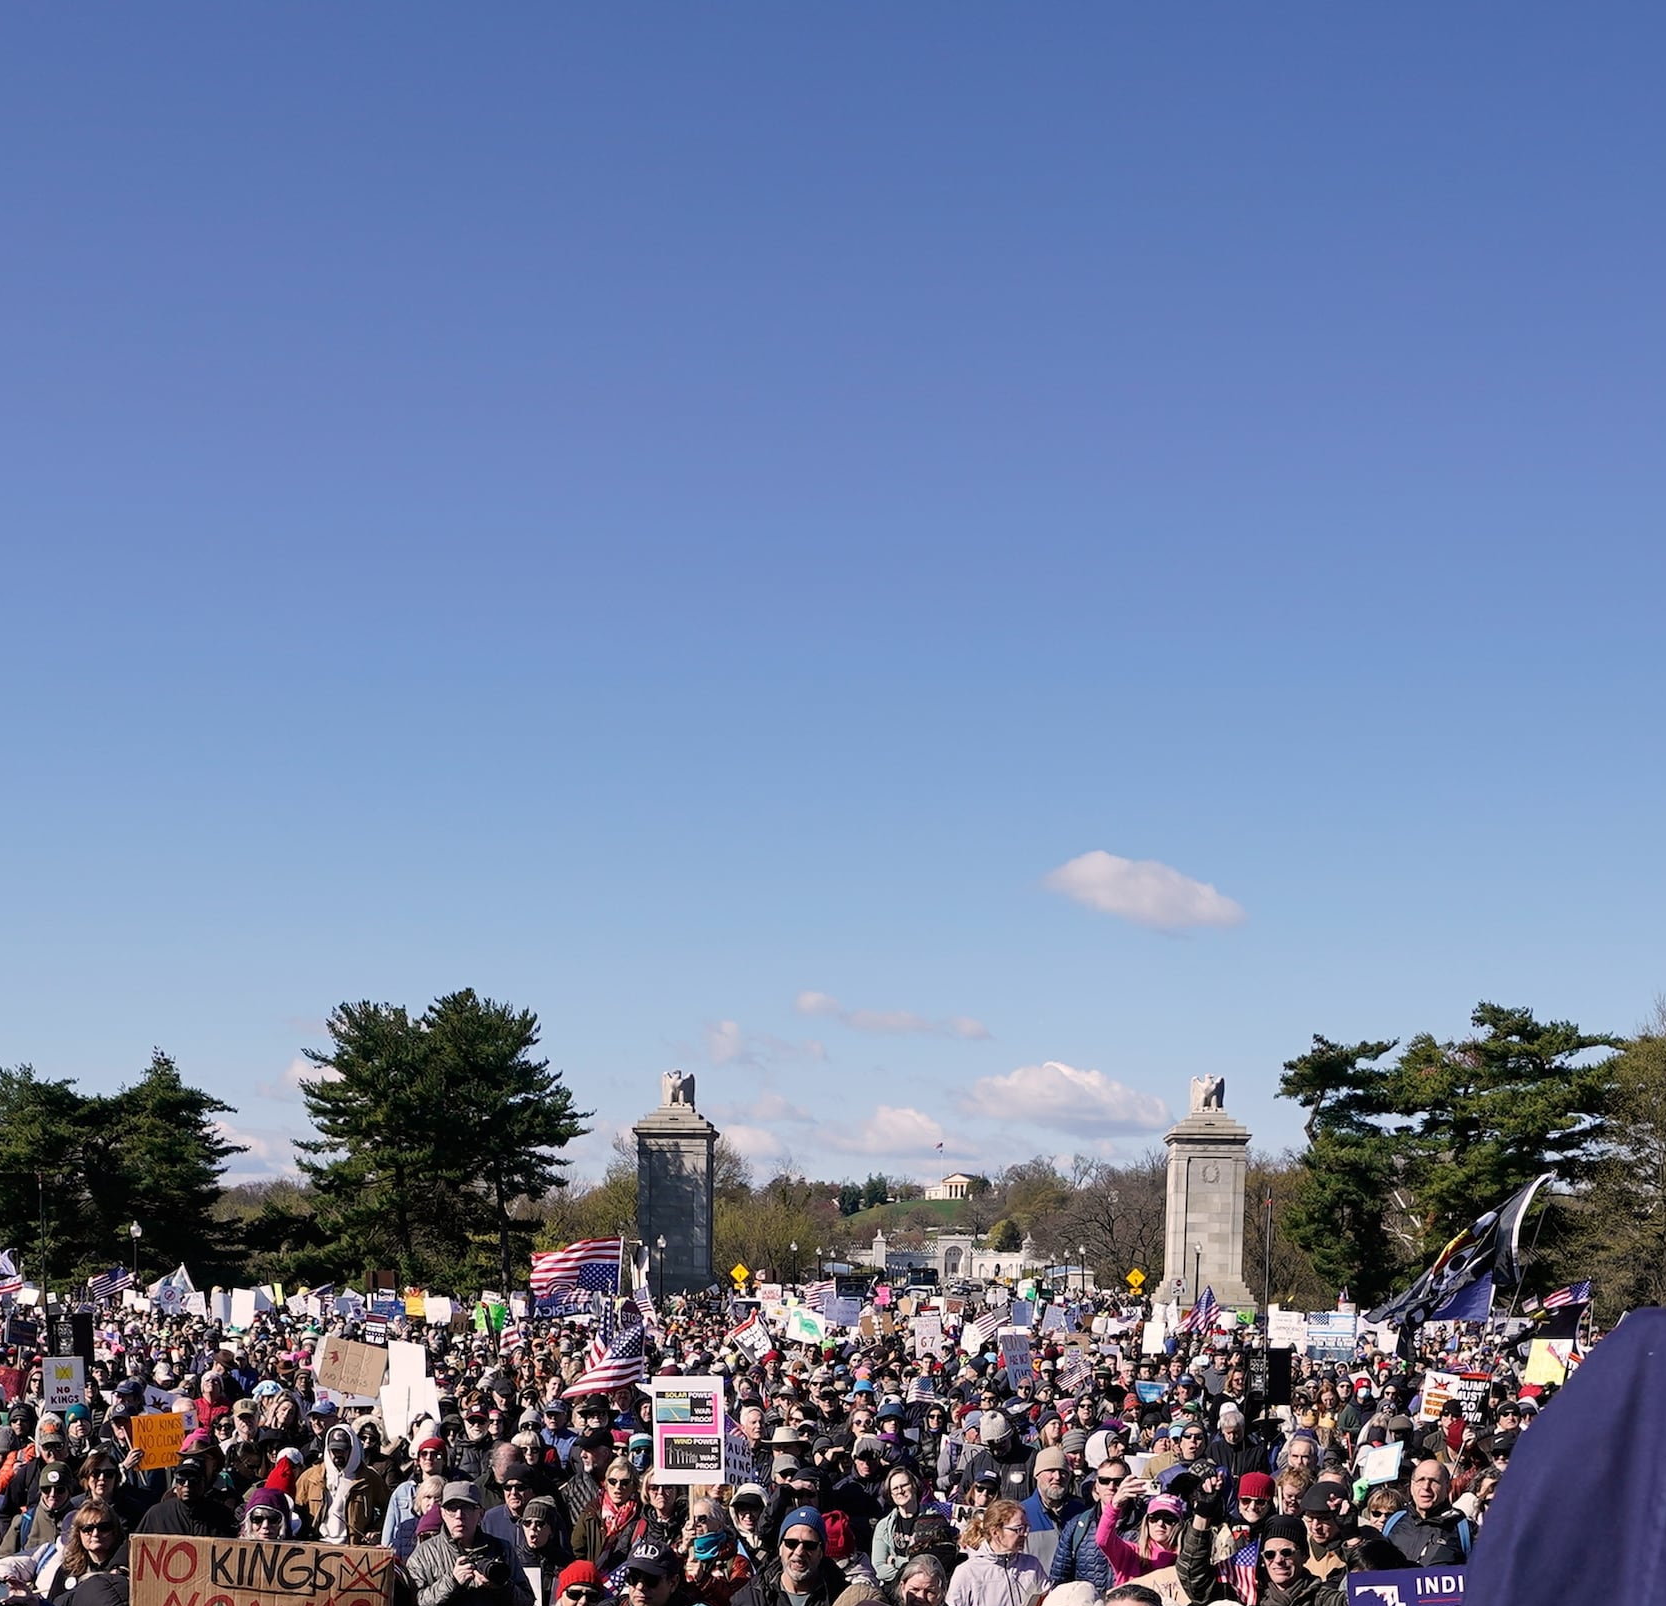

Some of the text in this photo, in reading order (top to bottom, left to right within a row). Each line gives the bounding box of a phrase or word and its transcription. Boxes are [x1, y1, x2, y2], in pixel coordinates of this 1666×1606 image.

[56, 1386, 71, 1394] NO
[688, 1391, 713, 1399] POWER
[50, 1395, 80, 1405] KINGS
[694, 1407, 713, 1415] WAR-
[690, 1415, 713, 1423] PROOF
[137, 1418, 154, 1433] NO
[139, 1433, 183, 1449] NO CLOWN
[673, 1438, 719, 1446] WIND POWER
[140, 1451, 156, 1466] NO
[137, 1540, 344, 1596] NO KINGS
[1416, 1575, 1464, 1595] INDI
